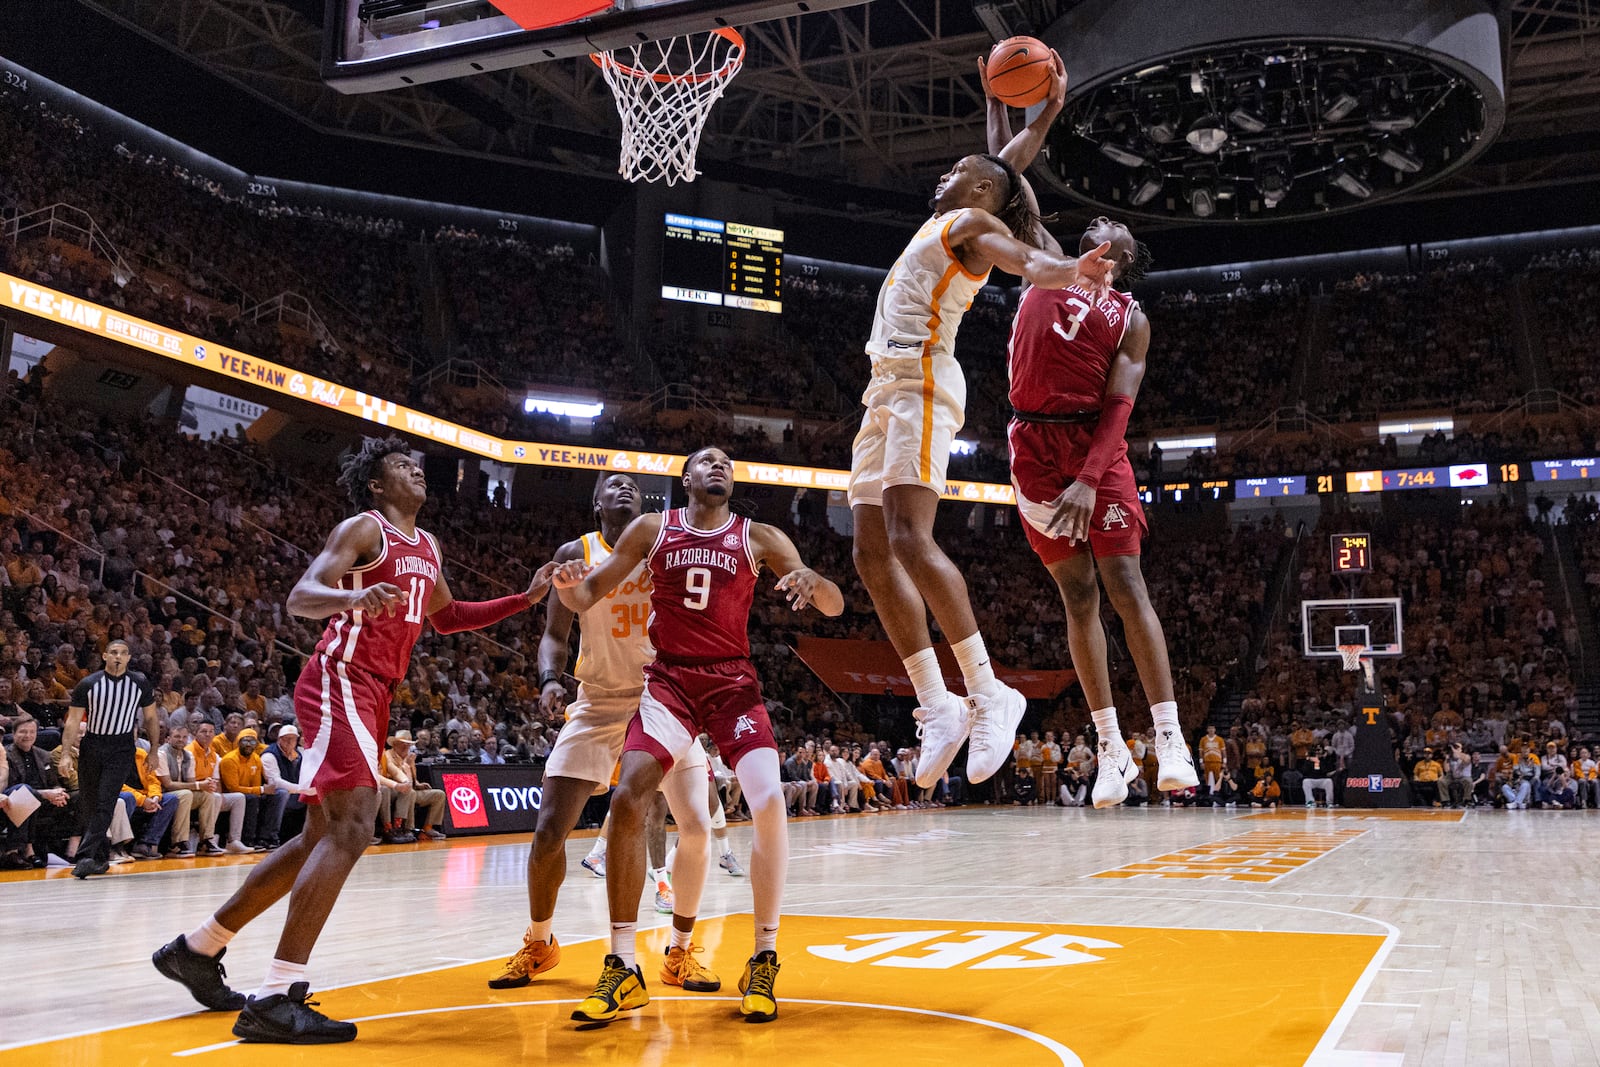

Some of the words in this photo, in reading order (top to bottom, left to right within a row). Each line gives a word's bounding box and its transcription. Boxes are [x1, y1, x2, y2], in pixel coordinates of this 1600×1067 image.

[4, 71, 28, 92] 324
[247, 183, 278, 197] 325A
[497, 219, 518, 231] 325
[1428, 248, 1448, 260] 329
[801, 264, 820, 276] 327
[1221, 270, 1241, 282] 328
[676, 289, 709, 301] JTEKT
[9, 281, 102, 329] YEE-HAW
[106, 318, 158, 347] BREWING
[163, 335, 182, 354] CO.
[1052, 297, 1091, 341] 3
[219, 352, 286, 387] YEE-HAW
[289, 374, 307, 395] Go
[311, 380, 345, 406] Vols!
[406, 412, 458, 443] YEE-HAW
[539, 449, 609, 466] YEE-HAW
[612, 452, 632, 469] Go
[637, 455, 675, 472] Vols!
[1571, 459, 1595, 467] FOULS
[747, 465, 812, 484] YEE-HAW
[1355, 472, 1375, 491] T
[1398, 471, 1435, 487] 7:44
[1500, 464, 1519, 482] 13
[963, 484, 980, 499] Go
[1213, 487, 1220, 500] 7
[1317, 475, 1333, 493] 21
[1342, 537, 1367, 548] 7:44
[665, 547, 738, 575] RAZORBACKS
[1340, 549, 1365, 569] 21
[395, 556, 438, 586] RAZORBACKS
[683, 567, 712, 611] 9
[404, 576, 426, 625] 11
[611, 603, 651, 638] 34
[1362, 707, 1380, 725] T
[1346, 777, 1369, 789] FOOD
[1382, 777, 1402, 789] CITY
[487, 787, 544, 811] TOYO
[806, 930, 1125, 970] SEC
